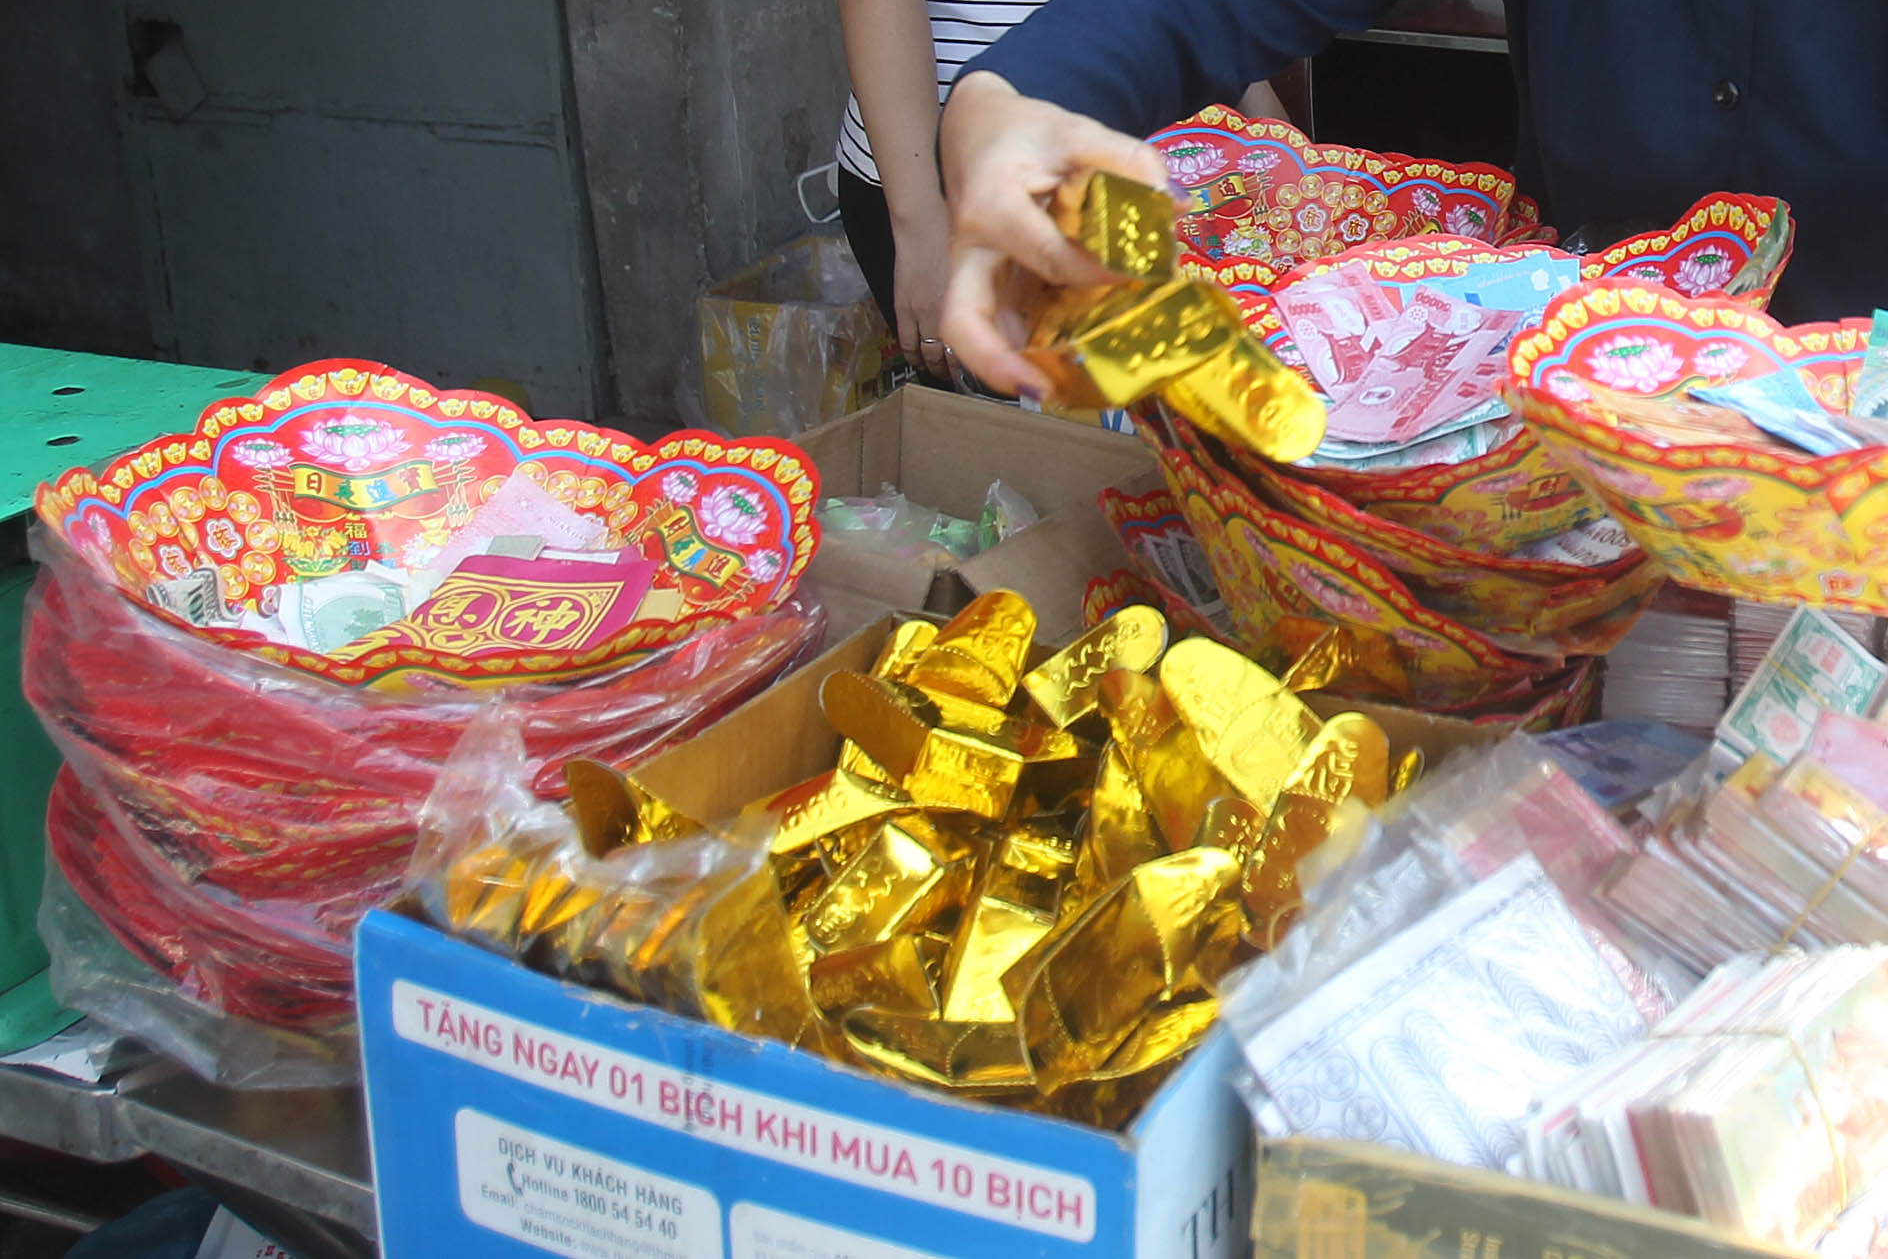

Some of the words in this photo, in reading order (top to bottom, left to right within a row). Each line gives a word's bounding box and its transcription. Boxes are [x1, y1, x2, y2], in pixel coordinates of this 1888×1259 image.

[416, 999, 502, 1057] TẶNG
[513, 1033, 599, 1089] NGAY
[609, 1066, 645, 1105] 01
[659, 1080, 743, 1136] BỊCH
[755, 1109, 818, 1157] KHI
[831, 1130, 918, 1185] MUA
[931, 1158, 974, 1198] 10
[986, 1172, 1085, 1228] BỊCH
[498, 1137, 536, 1166] DỊCH
[543, 1152, 565, 1177] VỤ
[571, 1161, 628, 1197] KHÁCH
[635, 1182, 683, 1216] HÀNG
[521, 1173, 569, 1203] Hotline
[574, 1188, 607, 1215] 1800
[611, 1202, 630, 1225] 54
[634, 1209, 654, 1232] 54
[658, 1218, 678, 1240] 40
